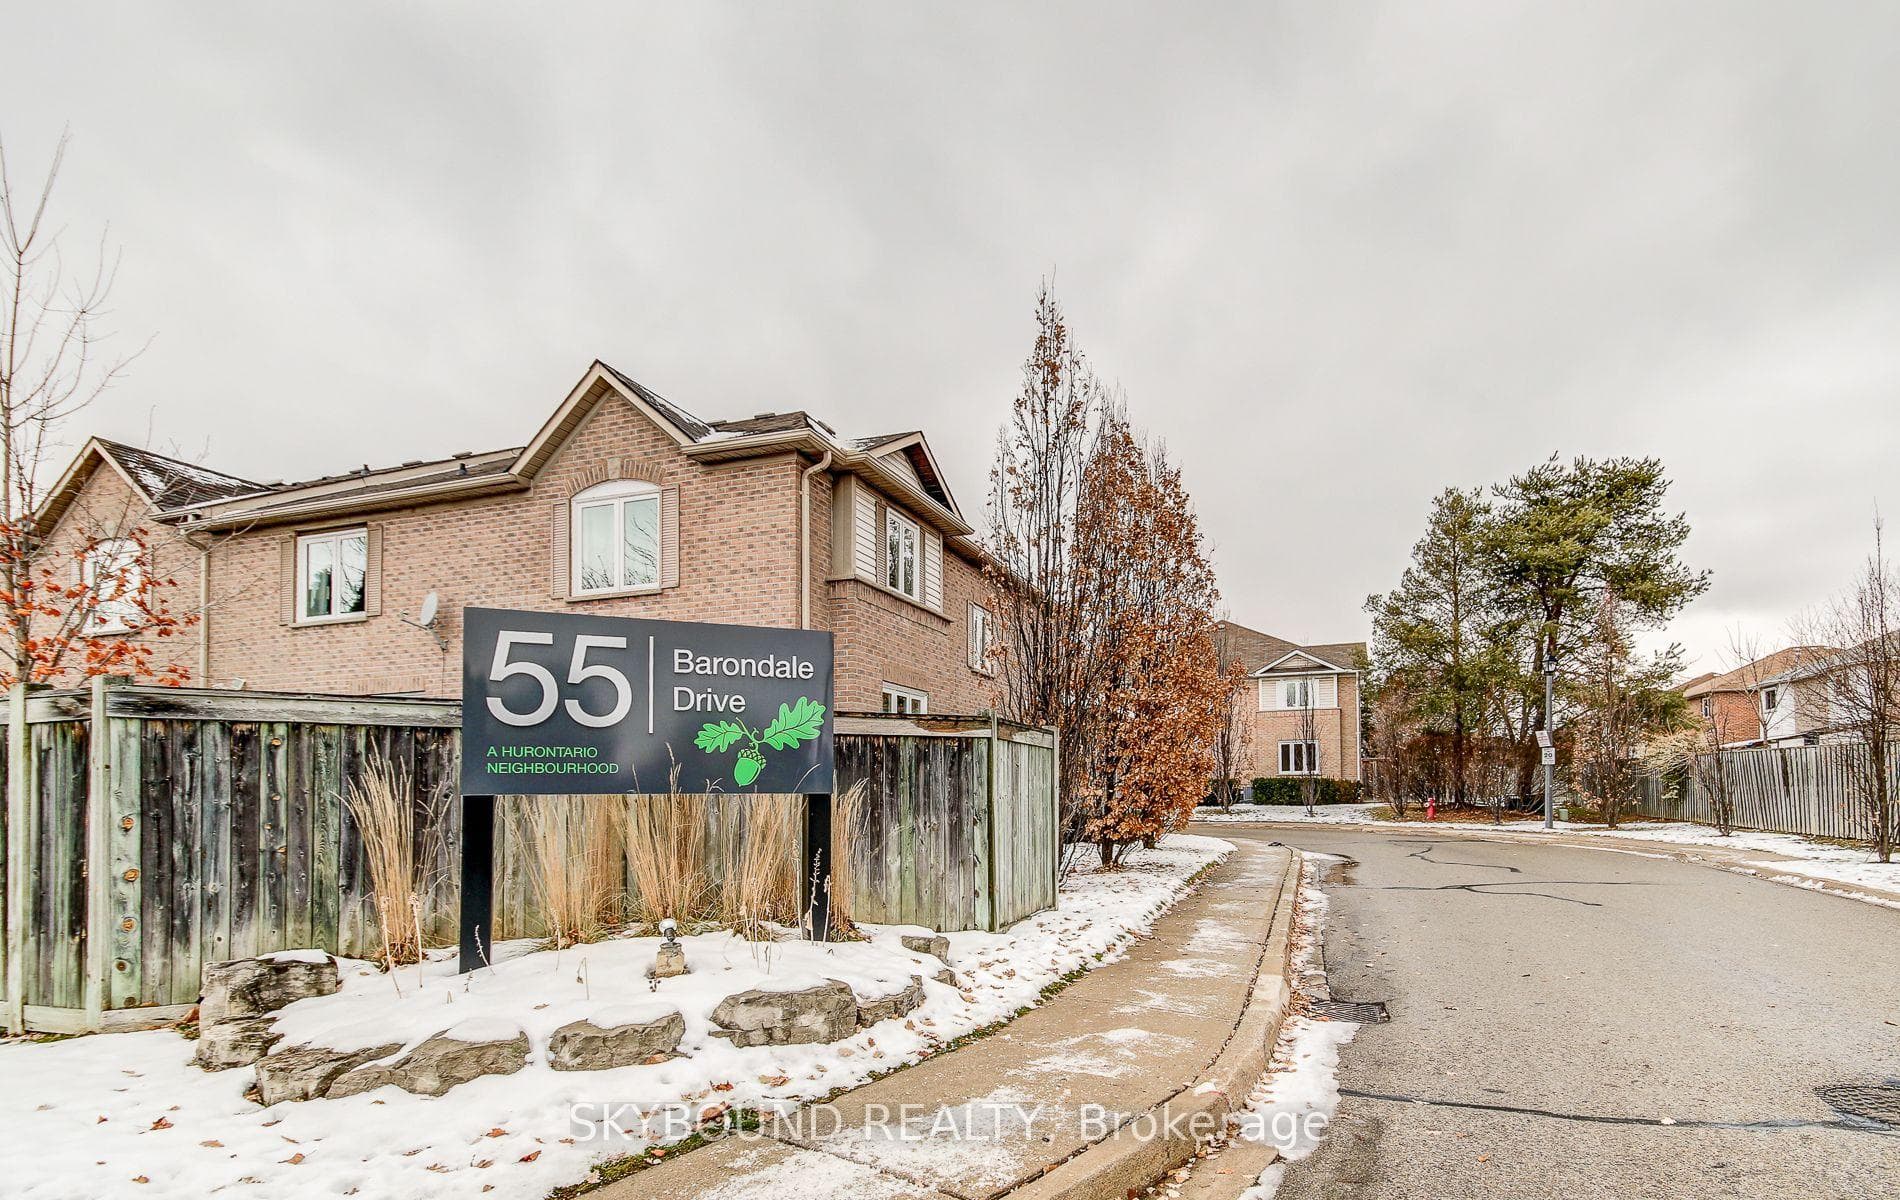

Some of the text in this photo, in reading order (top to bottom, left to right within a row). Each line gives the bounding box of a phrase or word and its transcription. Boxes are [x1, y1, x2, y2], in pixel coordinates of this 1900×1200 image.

[673, 648, 814, 680] Barondale
[486, 630, 632, 728] 55
[673, 686, 746, 713] Drive
[486, 746, 598, 758] A HURONTARIO
[487, 762, 619, 774] NEIGHBOURHOOD
